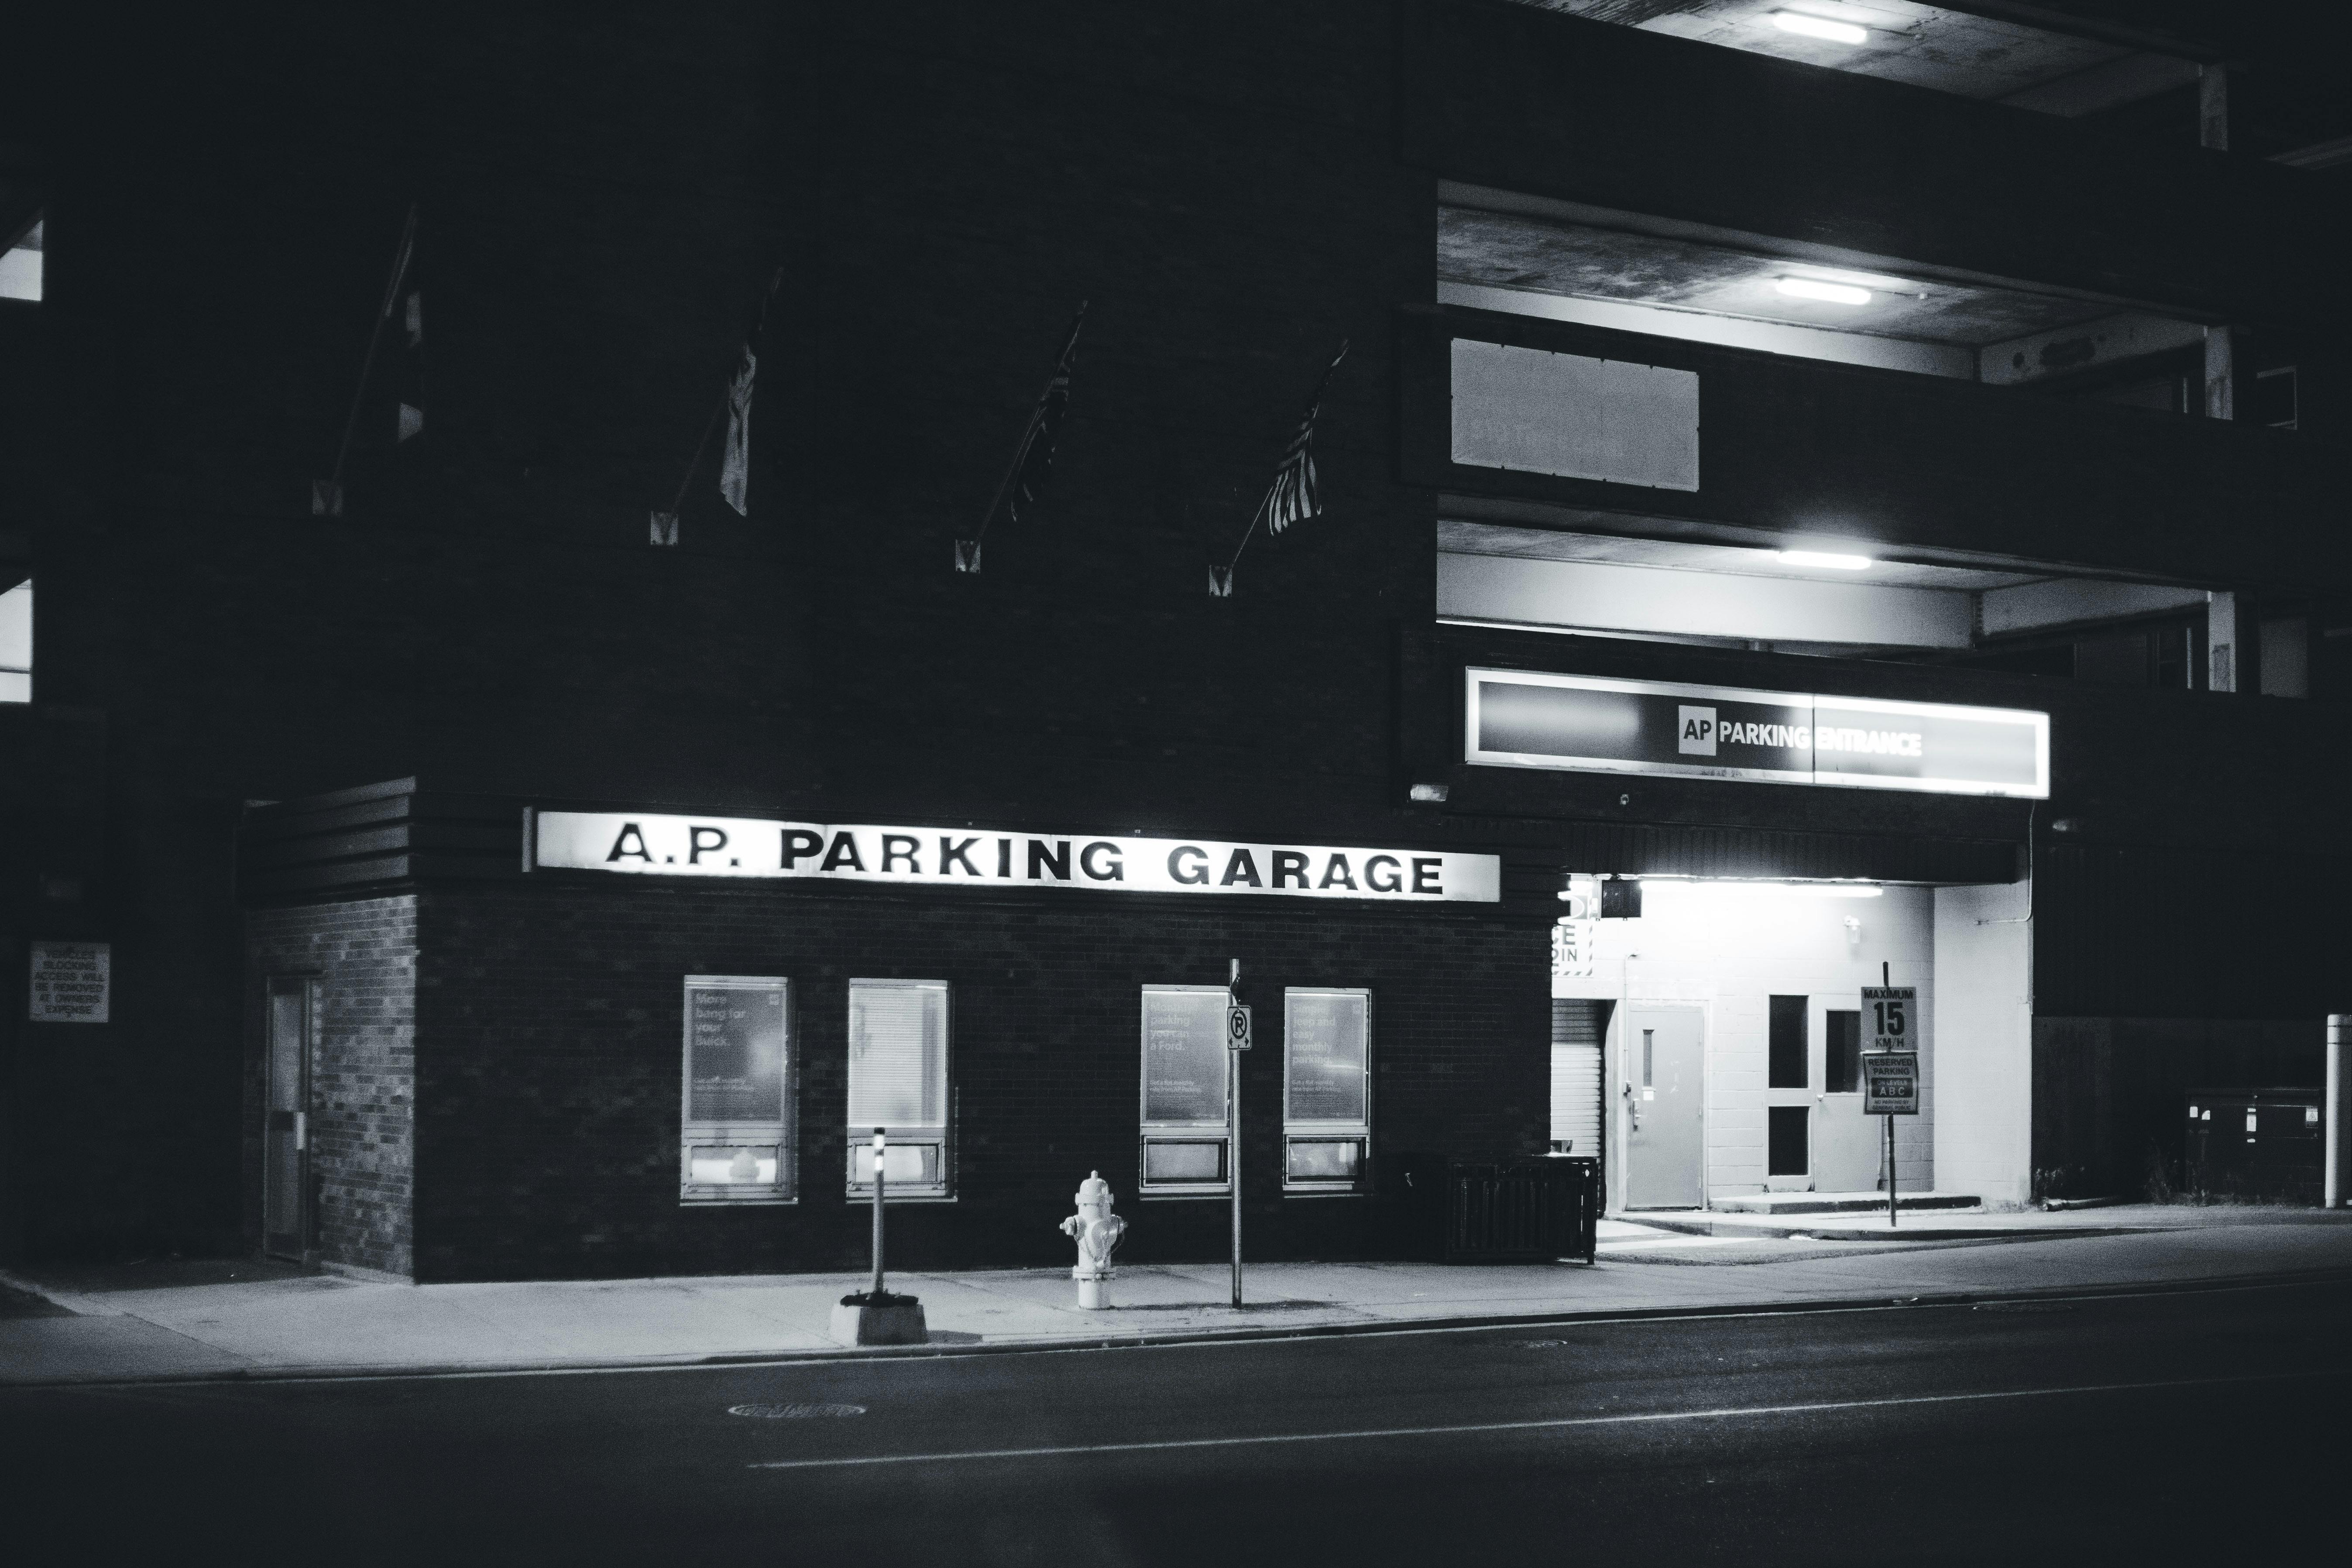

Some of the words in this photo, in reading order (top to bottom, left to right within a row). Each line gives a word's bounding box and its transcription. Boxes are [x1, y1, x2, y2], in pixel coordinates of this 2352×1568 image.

[1684, 719, 1712, 741] AP
[1720, 721, 1811, 749] PARKING
[1816, 726, 1922, 756] ENTRANCE
[606, 823, 738, 867] A.P.
[780, 828, 1125, 882] PARKING
[1167, 845, 1444, 894] GARAGE
[53, 984, 104, 992] REMOVED
[1864, 990, 1913, 999] MAXIMUM
[1874, 1002, 1905, 1036] 15
[1875, 1038, 1904, 1047] KM/H
